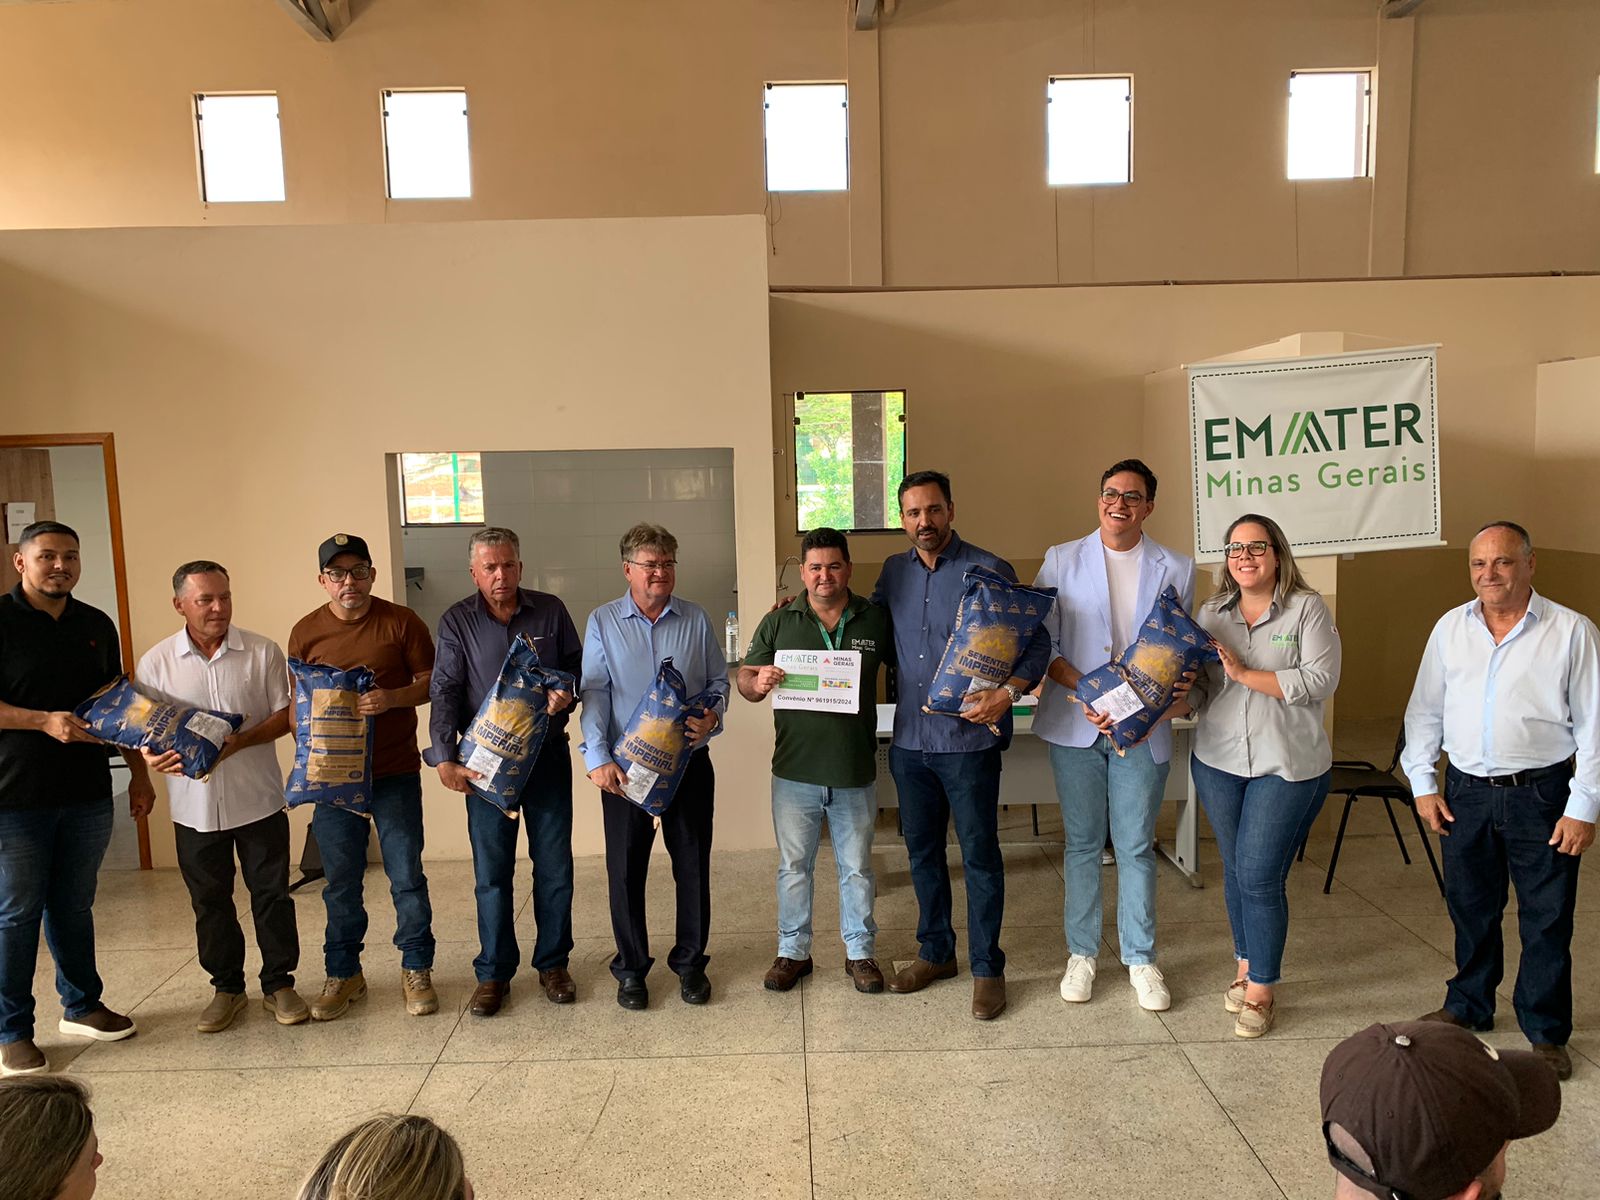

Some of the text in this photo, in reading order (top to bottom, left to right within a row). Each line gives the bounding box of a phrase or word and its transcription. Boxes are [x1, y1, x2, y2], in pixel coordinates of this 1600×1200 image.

[1204, 402, 1424, 461] EMATER
[1206, 456, 1426, 498] Minas Gerais
[967, 649, 1010, 669] SEMENTES
[475, 723, 524, 757] IMPERIAL
[483, 719, 525, 746] SEMENTES
[633, 736, 675, 761] SEMENTES
[624, 740, 674, 772] IMPERIAL
